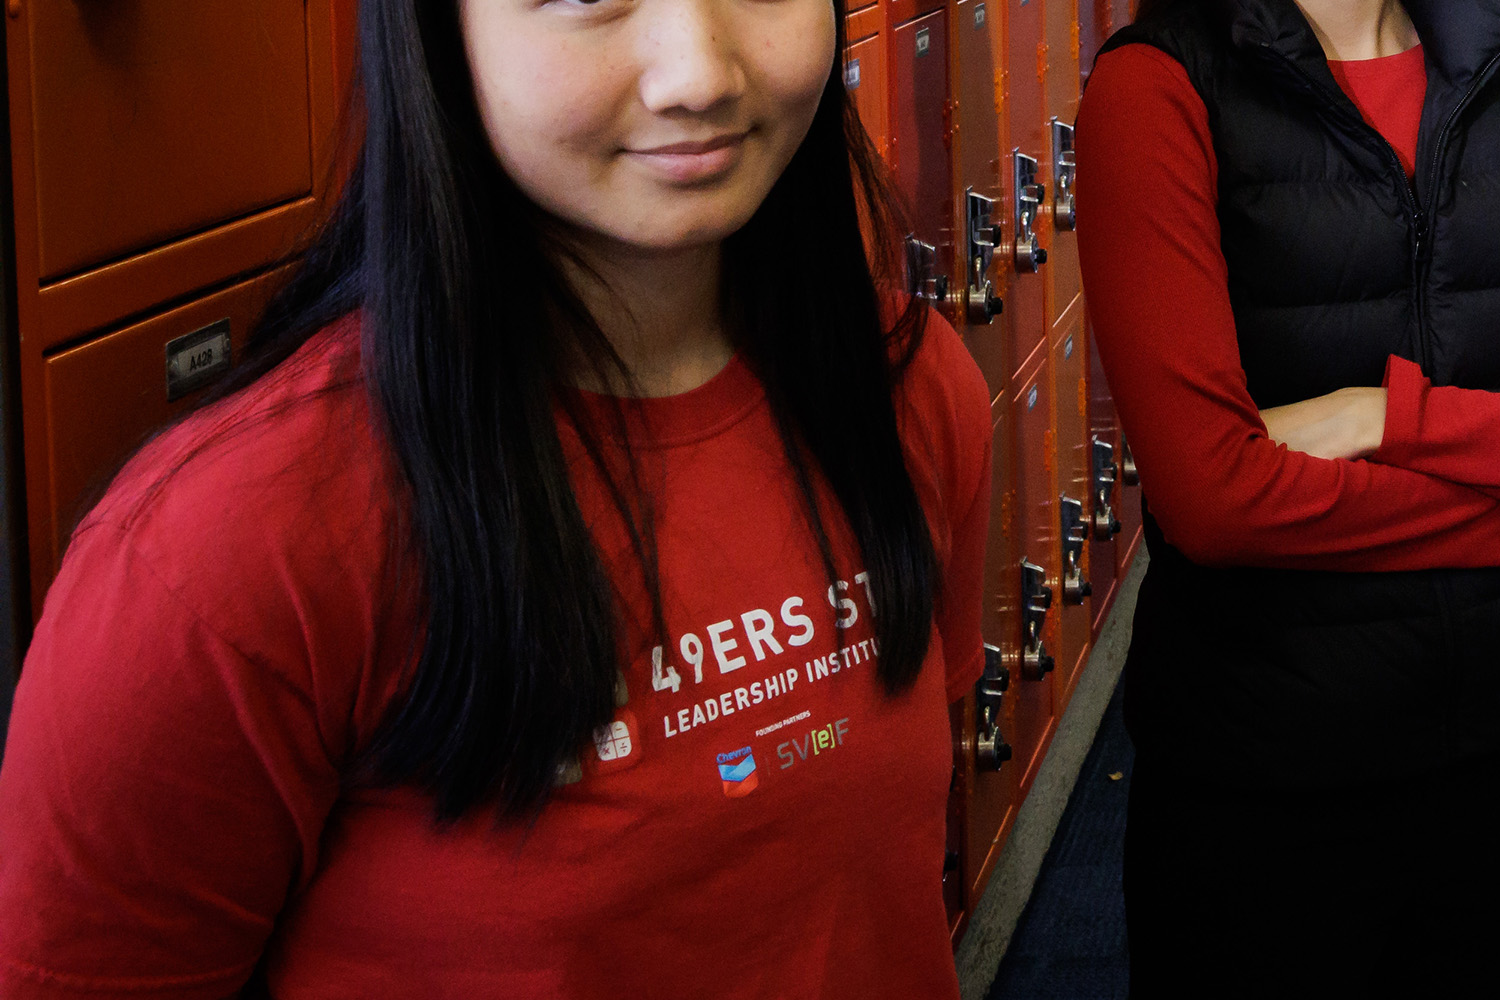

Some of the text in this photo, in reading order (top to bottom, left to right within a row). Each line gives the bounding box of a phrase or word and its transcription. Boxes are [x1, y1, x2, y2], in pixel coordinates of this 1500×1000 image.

[189, 348, 213, 372] A428
[651, 571, 877, 693] 49ERS ST
[664, 637, 879, 738] LEADERSHIP INSTIT
[716, 746, 752, 764] Chevron
